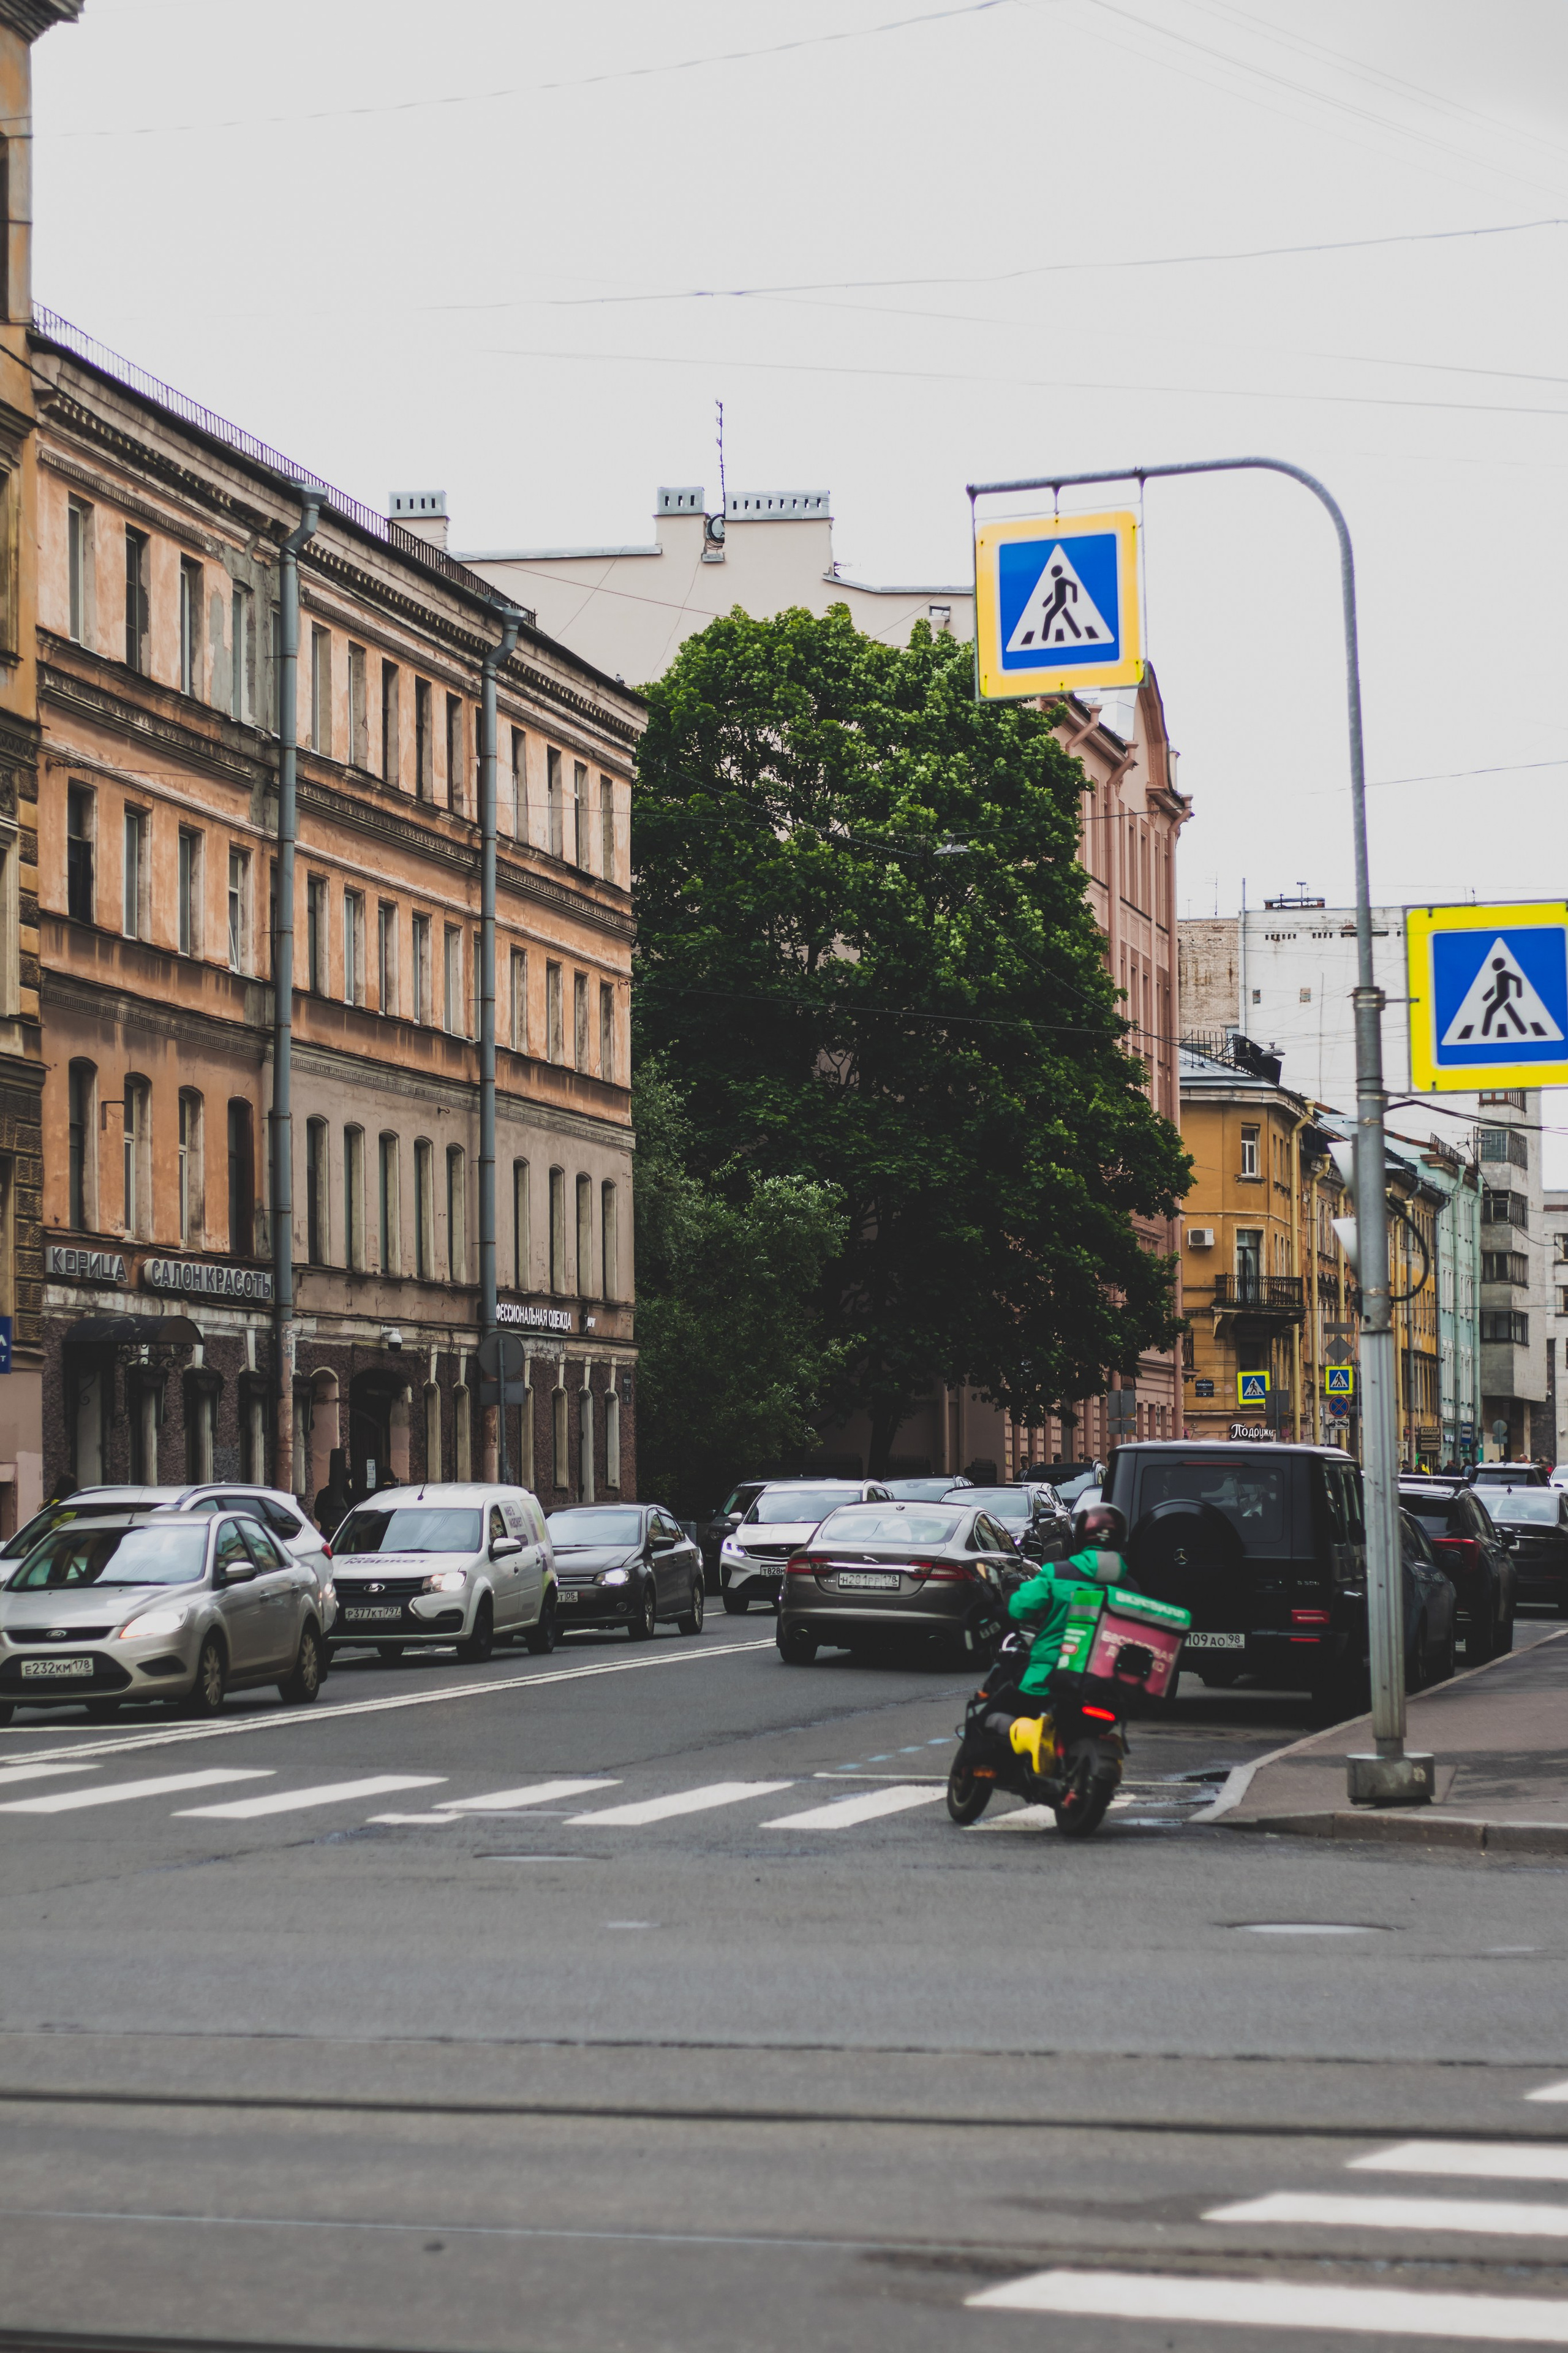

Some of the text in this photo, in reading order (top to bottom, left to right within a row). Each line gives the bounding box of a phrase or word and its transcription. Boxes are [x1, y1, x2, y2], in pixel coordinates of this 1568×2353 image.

[51, 1246, 128, 1282] КОРИЦА
[151, 1258, 274, 1299] САЛОН КРАСОТЫ
[548, 1310, 572, 1331] ОДЕЖДА
[348, 1608, 383, 1618] Р377КТ
[25, 1660, 90, 1675] Е232КМ 178
